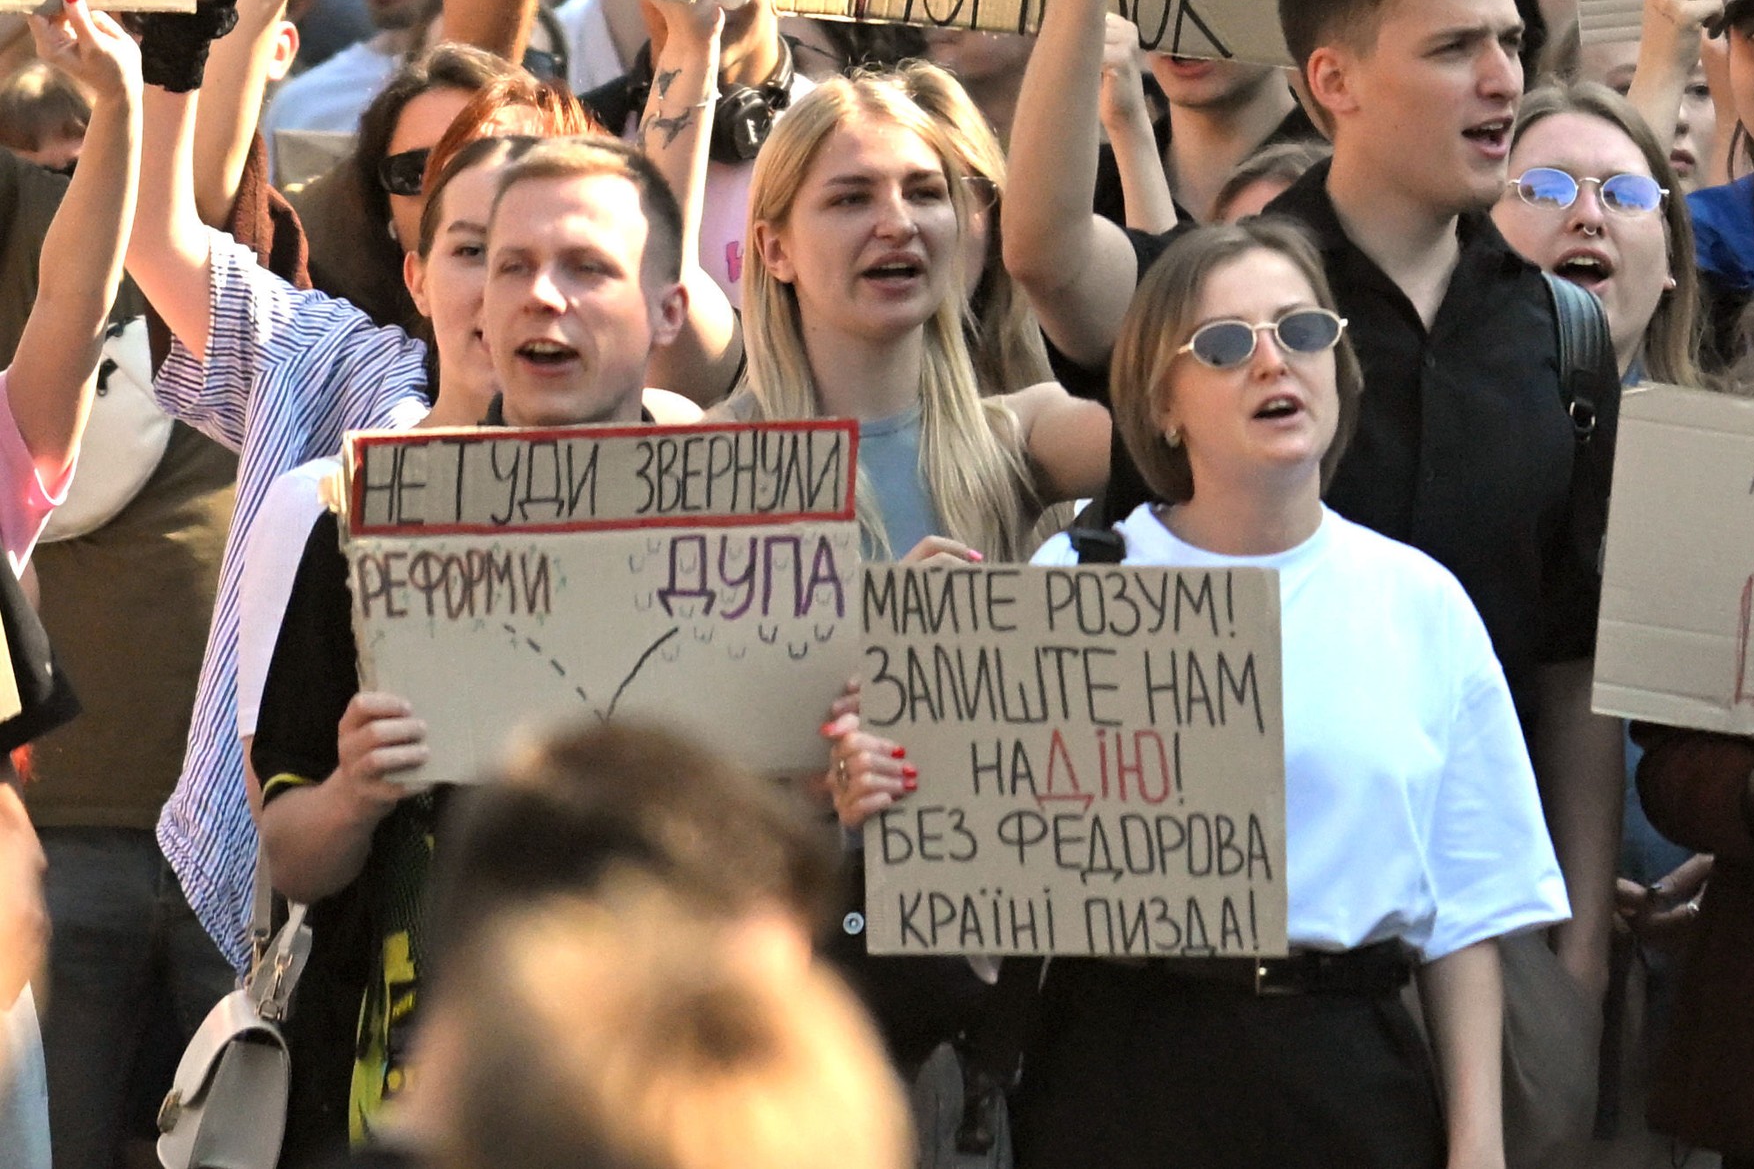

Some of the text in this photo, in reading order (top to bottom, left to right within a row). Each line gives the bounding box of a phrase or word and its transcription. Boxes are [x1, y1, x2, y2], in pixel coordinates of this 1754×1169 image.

[360, 426, 841, 525] НЕ ТУДИ ЗВЕРНУЛИ
[356, 533, 846, 621] РЕФОРМИ ДУПА
[862, 567, 1237, 638] МАЙТЕ РОЗУМ!
[865, 644, 1265, 734] ЗАЛИШТЕ НАМ
[971, 729, 1186, 812] НАДІЮ!
[879, 805, 1273, 885] БЕЗ ФЕДОРОВА
[899, 885, 1262, 957] КРАЇНІ ПИЗДА!
